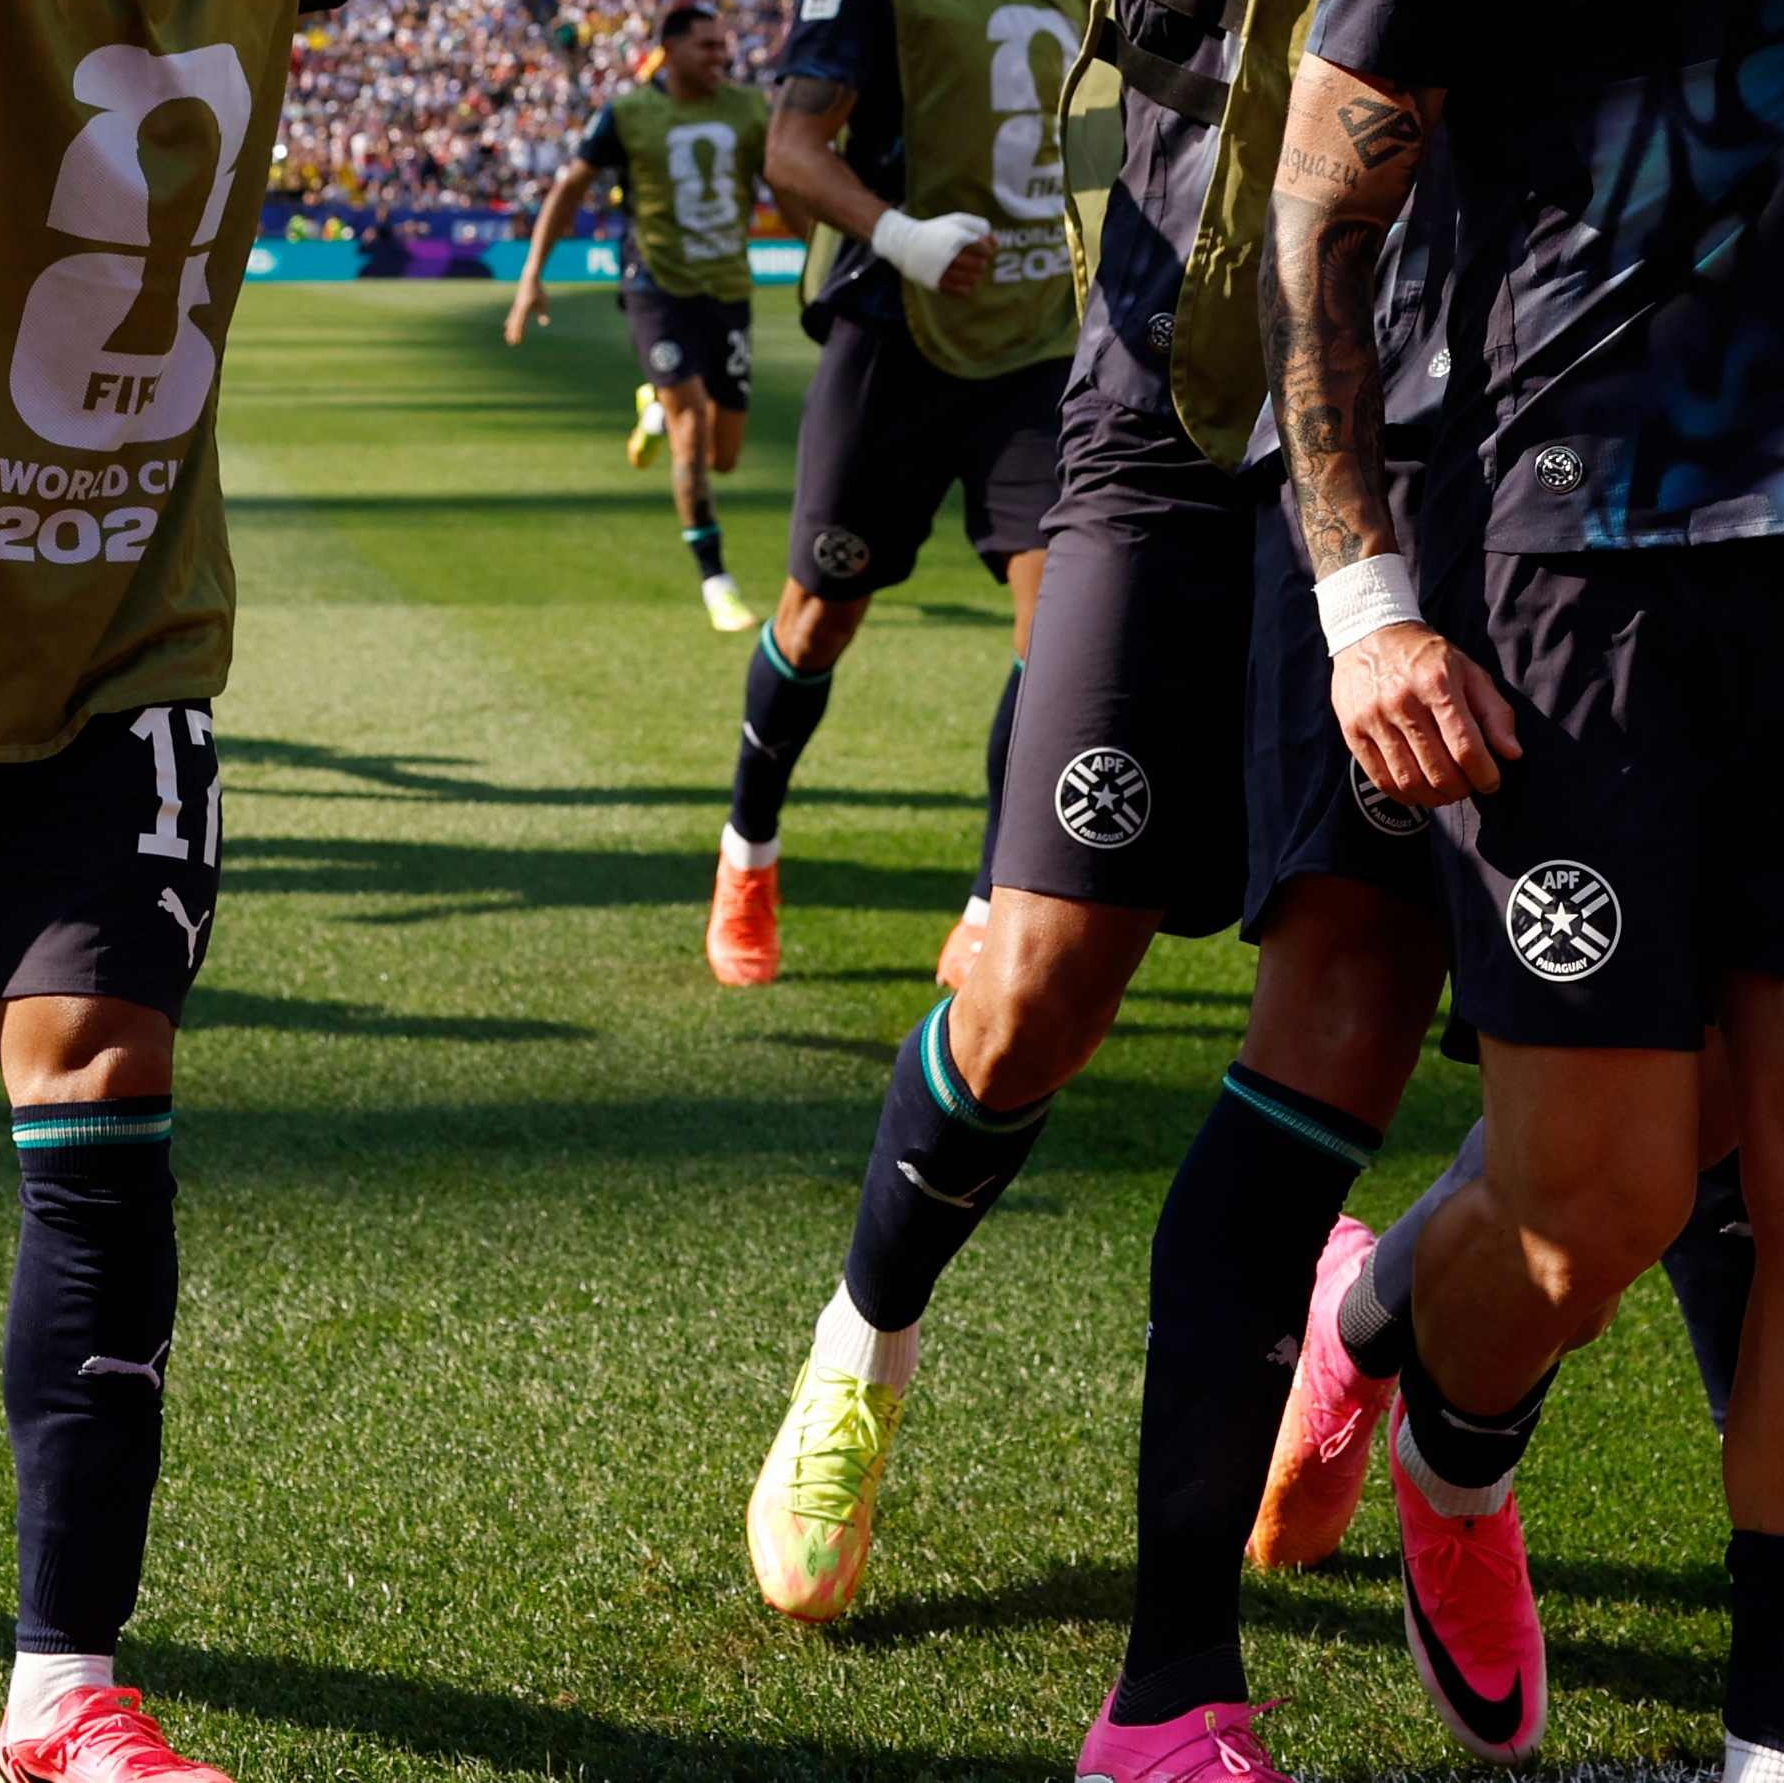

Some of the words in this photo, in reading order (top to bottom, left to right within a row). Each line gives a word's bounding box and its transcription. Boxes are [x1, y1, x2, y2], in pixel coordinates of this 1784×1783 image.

[1091, 755, 1125, 774] APF
[129, 707, 221, 868] 17
[1079, 826, 1124, 842] PARAGUAY
[1542, 871, 1580, 890] APF
[1535, 956, 1588, 973] PARAGUAY
